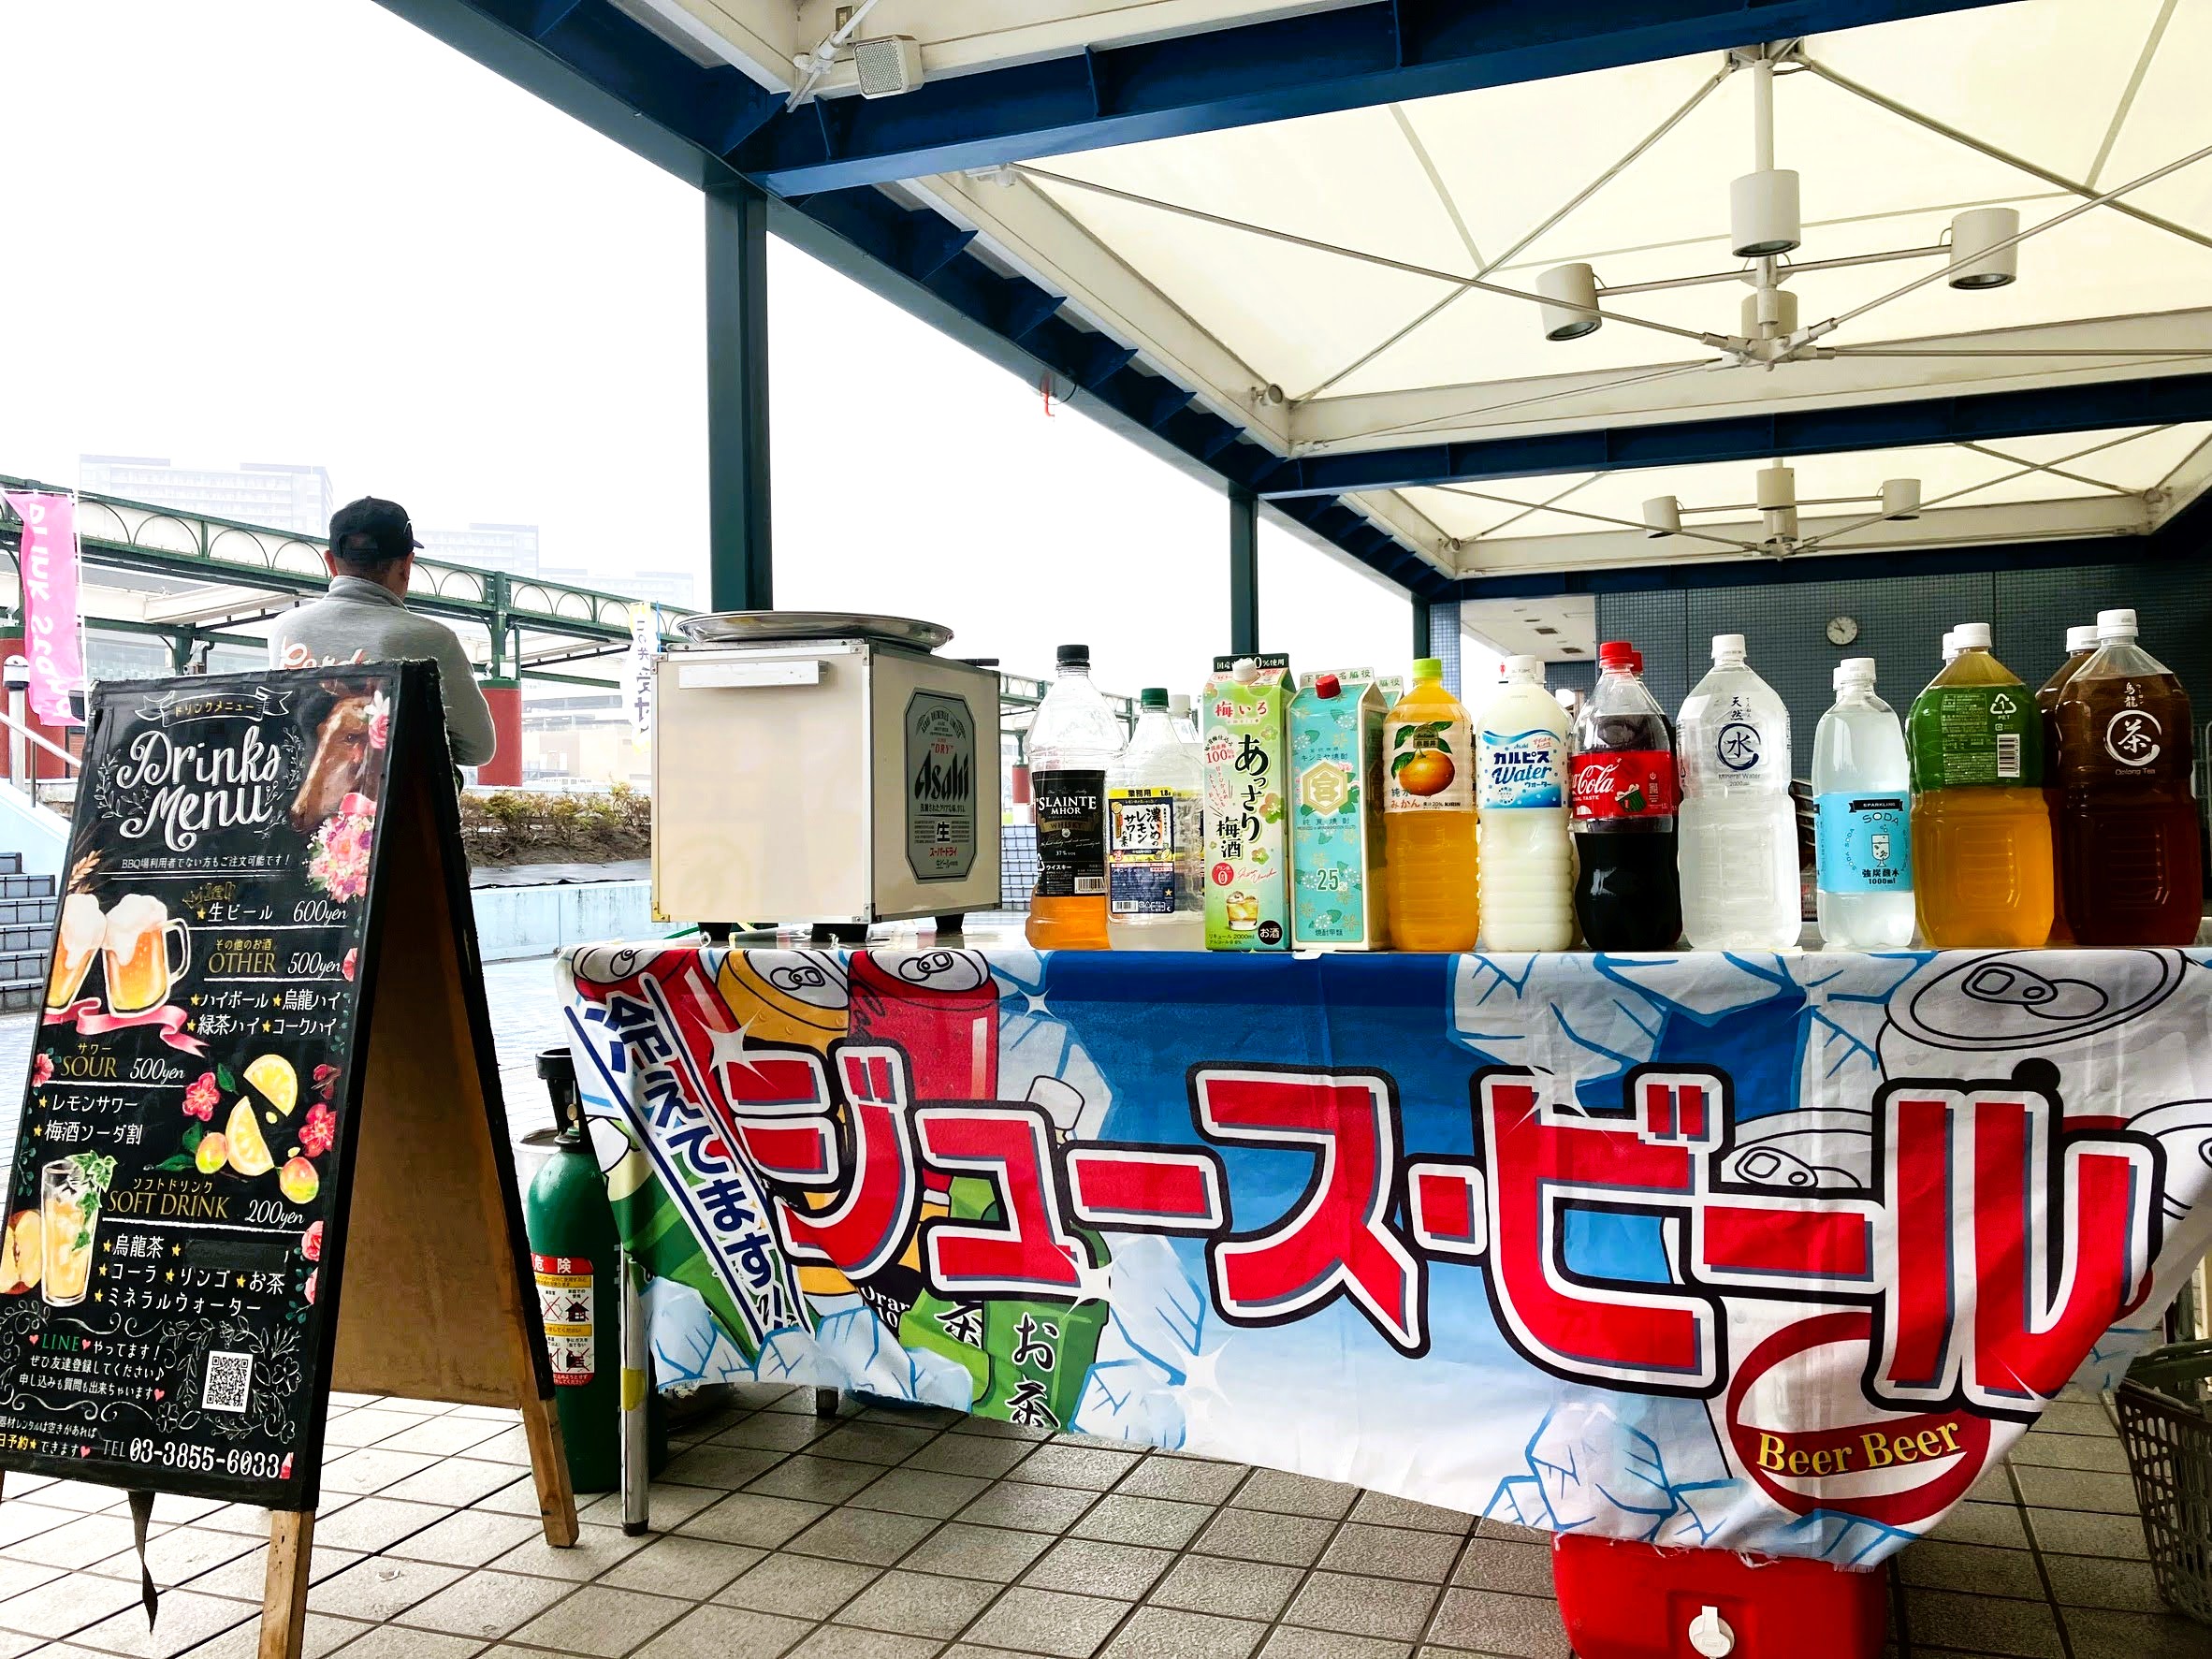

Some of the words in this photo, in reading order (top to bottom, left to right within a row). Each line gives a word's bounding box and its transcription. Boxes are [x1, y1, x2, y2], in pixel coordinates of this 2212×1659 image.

[175, 701, 255, 717] ドリンクメニュー
[1215, 701, 1267, 717] 梅いろ
[1730, 696, 1743, 720] 天然
[1726, 731, 1754, 759] 水
[2117, 719, 2152, 753] 茶
[116, 725, 281, 789] Drinks
[1493, 750, 1550, 764] カルピス
[914, 749, 969, 802] Asahi
[1492, 764, 1552, 784] Water
[1128, 789, 1151, 797] 業務用
[1235, 734, 1269, 841] あっさり
[1391, 798, 1420, 808] みかん
[119, 784, 272, 852] Menu
[1124, 814, 1136, 841] サワー
[1136, 810, 1148, 844] レモン
[1145, 806, 1161, 847] 濃いめの
[1862, 812, 1899, 825] SODA
[936, 821, 951, 842] 生
[1216, 816, 1242, 858] 梅酒
[929, 847, 958, 857] スーパードライ
[1861, 868, 1899, 878] 強炭酸水
[208, 902, 273, 923] 生ビール
[293, 899, 348, 925] 600yen
[216, 939, 273, 951] その他のお酒
[1259, 927, 1280, 939] お酒
[209, 953, 276, 973] OTHER
[287, 953, 342, 978] 500yen
[200, 990, 269, 1009] ハイボール
[196, 1014, 260, 1036] 緑茶ハイ
[272, 1017, 337, 1036] コークハイ
[78, 1042, 111, 1055] サワー
[61, 1055, 117, 1078] SOUR
[129, 1057, 185, 1084] 500yen
[52, 1094, 138, 1115] レモンサワー
[44, 1119, 143, 1145] 梅酒ソーダ割
[133, 1177, 212, 1193] ソフトドリンク
[108, 1190, 158, 1215] SOFT
[159, 1194, 229, 1219] DRINK
[244, 1199, 307, 1230] 200yen
[534, 1256, 572, 1273] 危険
[111, 1263, 157, 1284] コーラ
[181, 1269, 230, 1288] リンゴ
[249, 1271, 286, 1295] お茶
[108, 1287, 261, 1317] ミネラルウォーター
[42, 1333, 80, 1352] LINE
[1005, 1312, 1061, 1428] お茶
[41, 1441, 80, 1457] できます
[103, 1439, 125, 1457] TEL
[130, 1437, 279, 1478] 03-3855-6033
[1756, 1433, 1853, 1476] Beer
[1859, 1421, 1962, 1469] Beer
